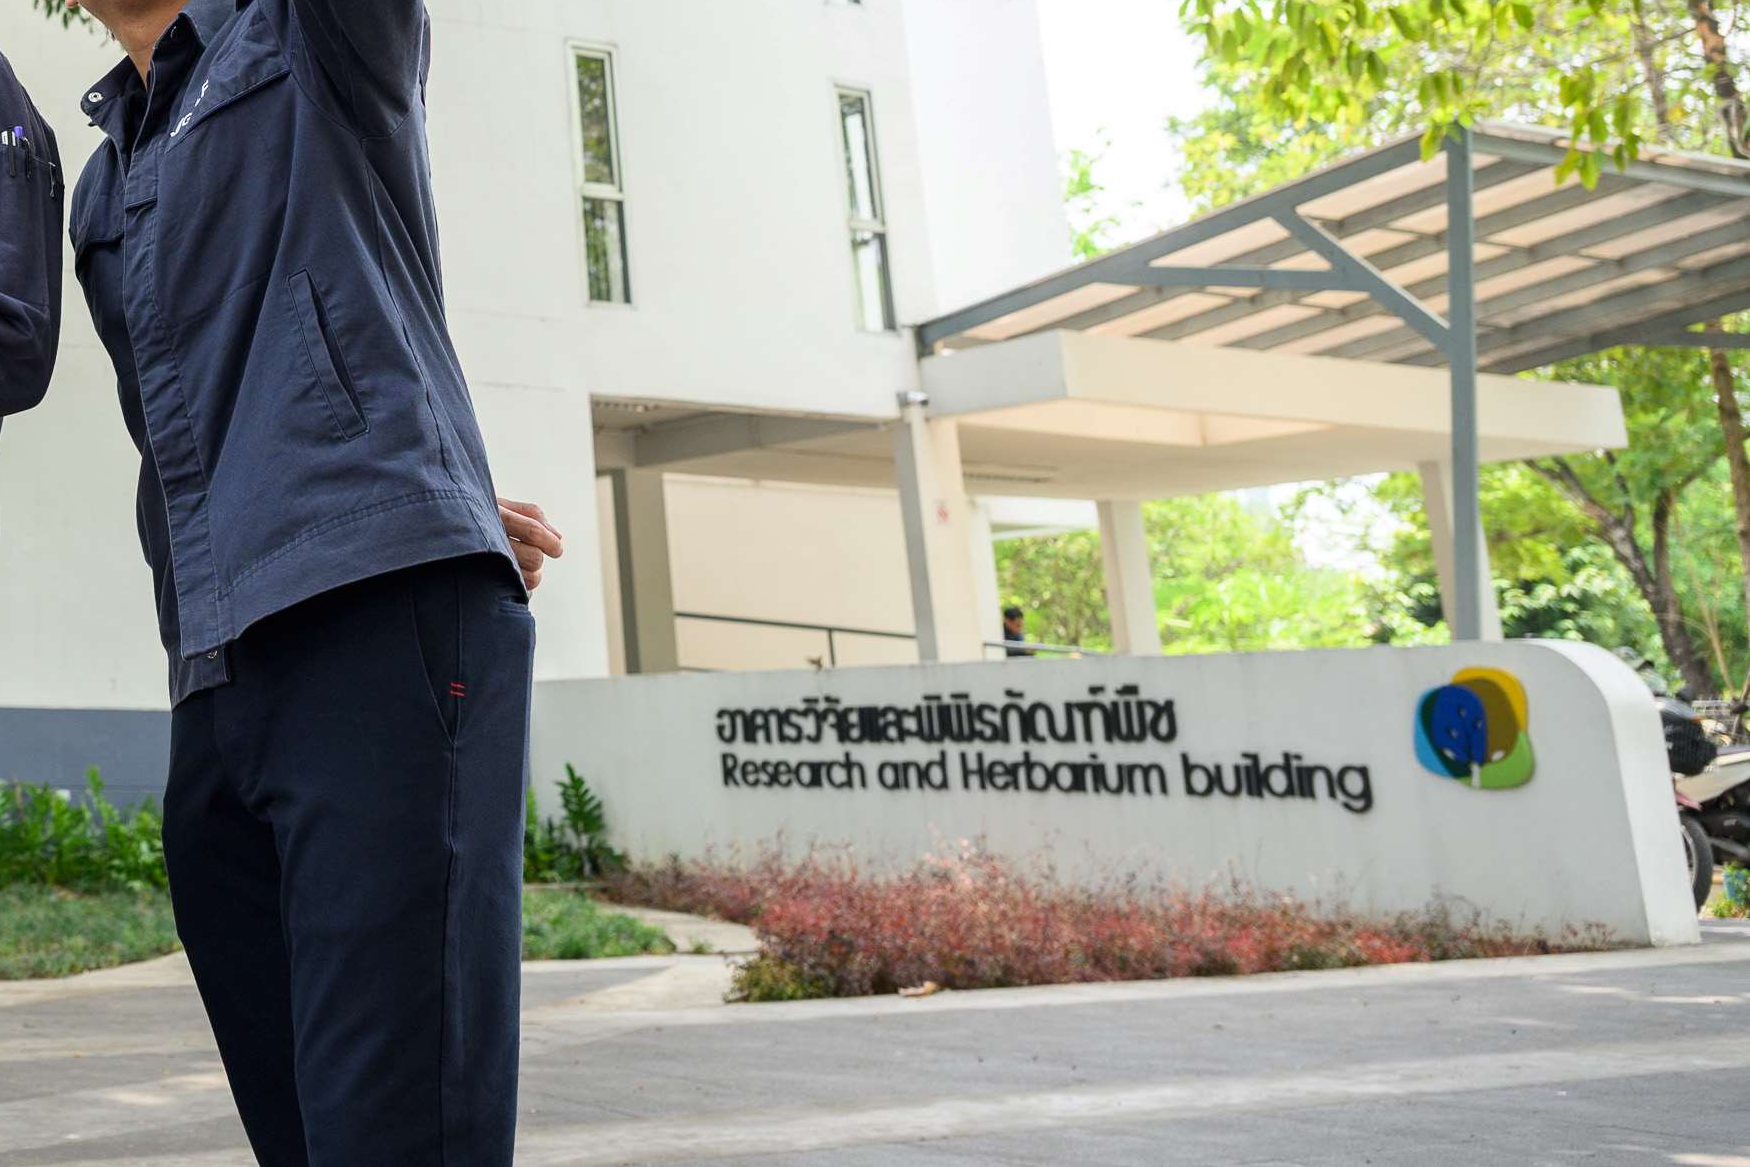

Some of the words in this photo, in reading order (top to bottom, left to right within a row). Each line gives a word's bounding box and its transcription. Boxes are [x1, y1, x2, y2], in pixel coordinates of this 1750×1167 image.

[721, 750, 867, 790] Research
[876, 749, 950, 790] and
[959, 749, 1168, 795] Herbarium
[1180, 750, 1374, 814] building
